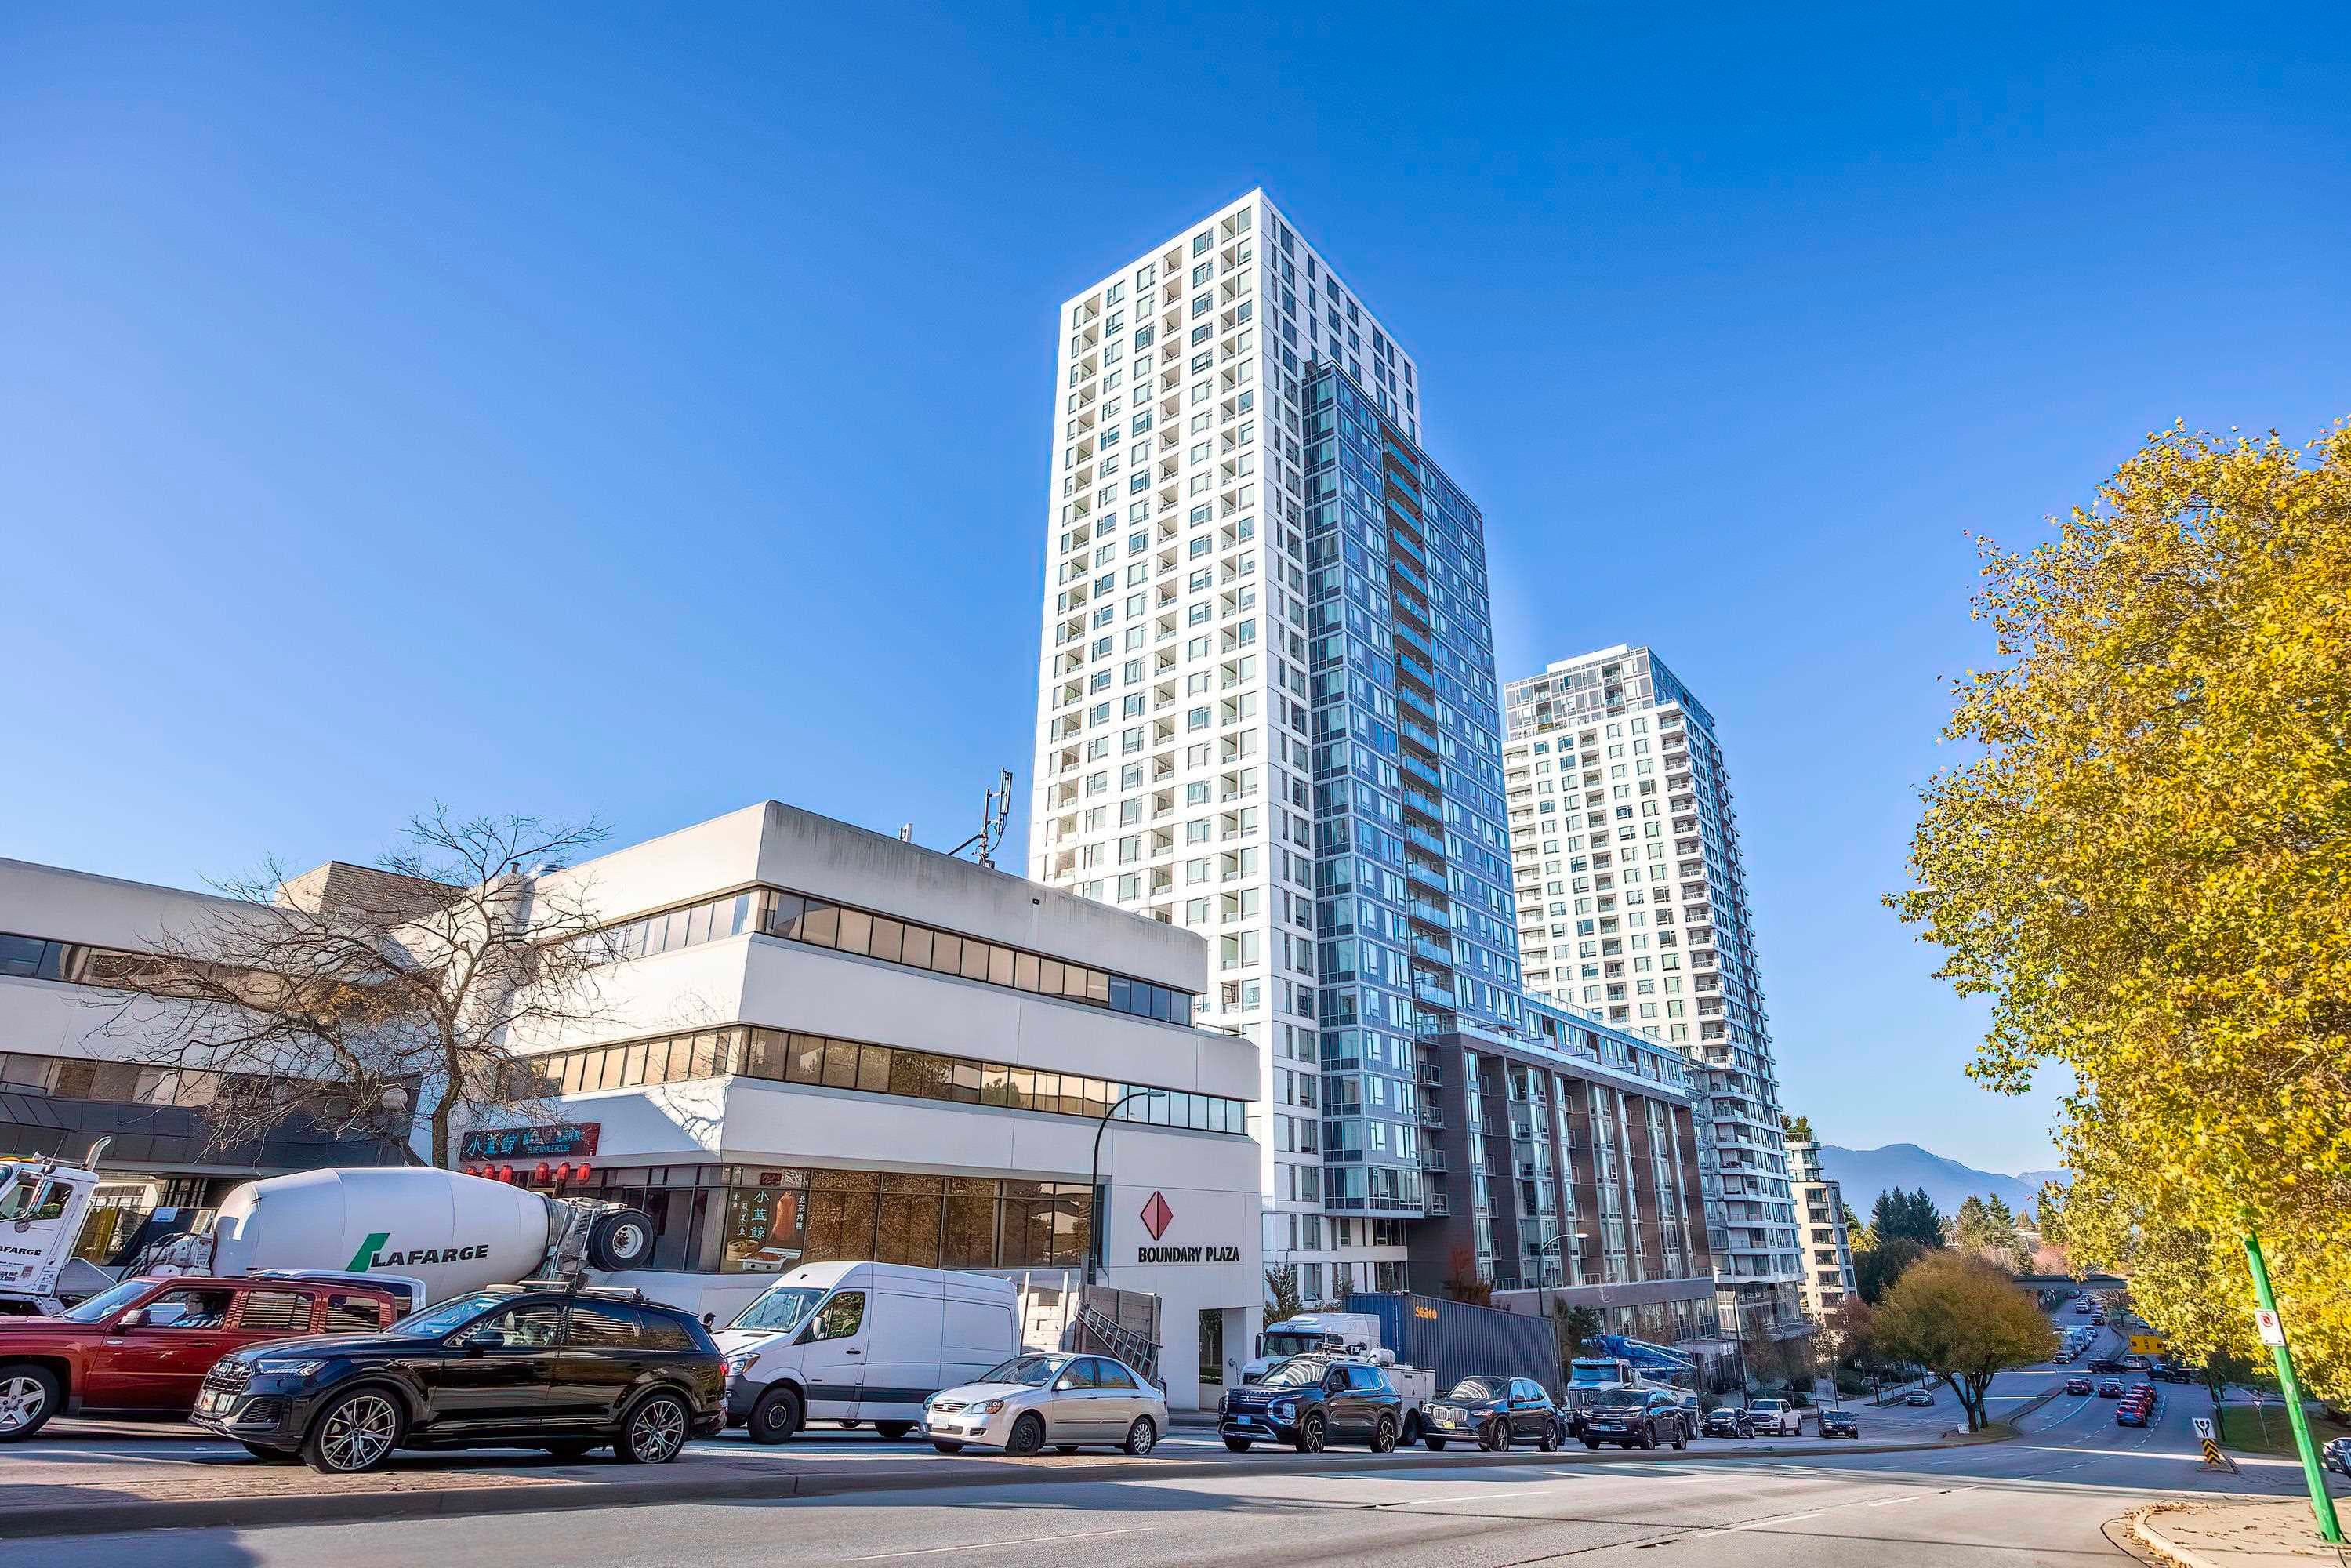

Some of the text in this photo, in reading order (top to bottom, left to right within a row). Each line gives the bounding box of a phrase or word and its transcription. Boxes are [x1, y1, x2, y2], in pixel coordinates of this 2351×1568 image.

[371, 1244, 489, 1268] LAFARGE
[1138, 1247, 1240, 1263] BOUNDARY PLAZA
